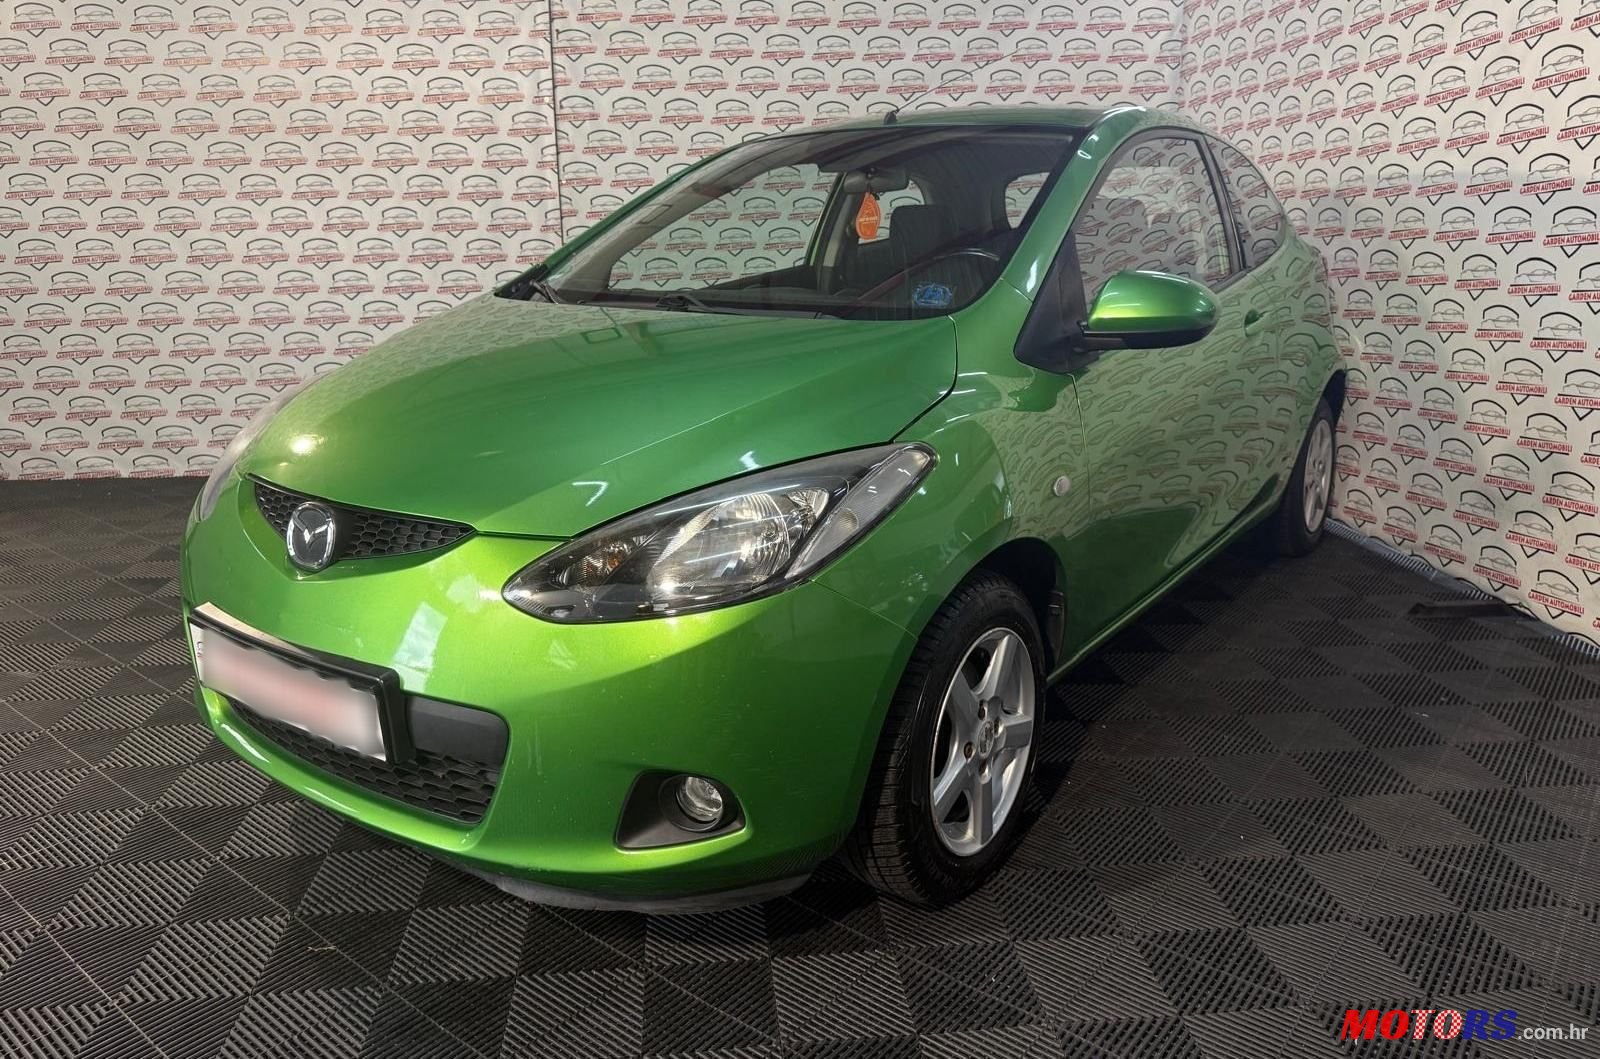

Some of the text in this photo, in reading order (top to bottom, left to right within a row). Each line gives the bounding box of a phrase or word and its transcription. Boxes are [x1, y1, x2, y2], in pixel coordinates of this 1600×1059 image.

[1508, 17, 1562, 43] GARDEN AUTOMOBILI
[1571, 16, 1593, 31] GARDEN
[1454, 31, 1502, 54] GARDEN AUTOMOBILI
[1532, 67, 1588, 91] GARDEN AUTOMOBILI
[1475, 77, 1523, 99] GARDEN AUTOMOBILI
[1424, 86, 1470, 106] GARDEN AUTOMOBILI
[1496, 126, 1548, 145] GARDEN AUTOMOBILI
[1557, 129, 1579, 141] GARDEN
[1464, 180, 1512, 196] GARDEN AUTOMOBILI
[1520, 178, 1574, 195] GARDEN AUTOMOBILI
[1583, 183, 1600, 194] GARD
[1486, 231, 1535, 244] GARDEN AUTOMOBILI
[1543, 233, 1600, 246] GARDEN AUTOMOBIL
[1472, 279, 1500, 288] AUTOMOBILI
[1528, 285, 1560, 293] AUTOMOBILI
[1515, 385, 1547, 394] AUTOMOBILI
[1554, 397, 1576, 405] GARDEN
[1463, 424, 1510, 436] GARDEN AUTOMOBILI
[1517, 439, 1571, 453] GARDEN AUTOMOBILI
[1580, 456, 1600, 465] GARDE
[1483, 477, 1534, 492] GARDEN AUTOMOBILI
[1541, 496, 1599, 514] GARDEN AUTOMOBILI
[1453, 512, 1499, 529] GARDEN AUTOMOBILI
[1506, 533, 1557, 552] GARDEN AUTOMOBILI
[1565, 556, 1587, 569] GARDEN
[1474, 566, 1521, 587] GARDEN AUTOMOBILI
[1529, 591, 1583, 615] GARDEN AUTOMOBILI
